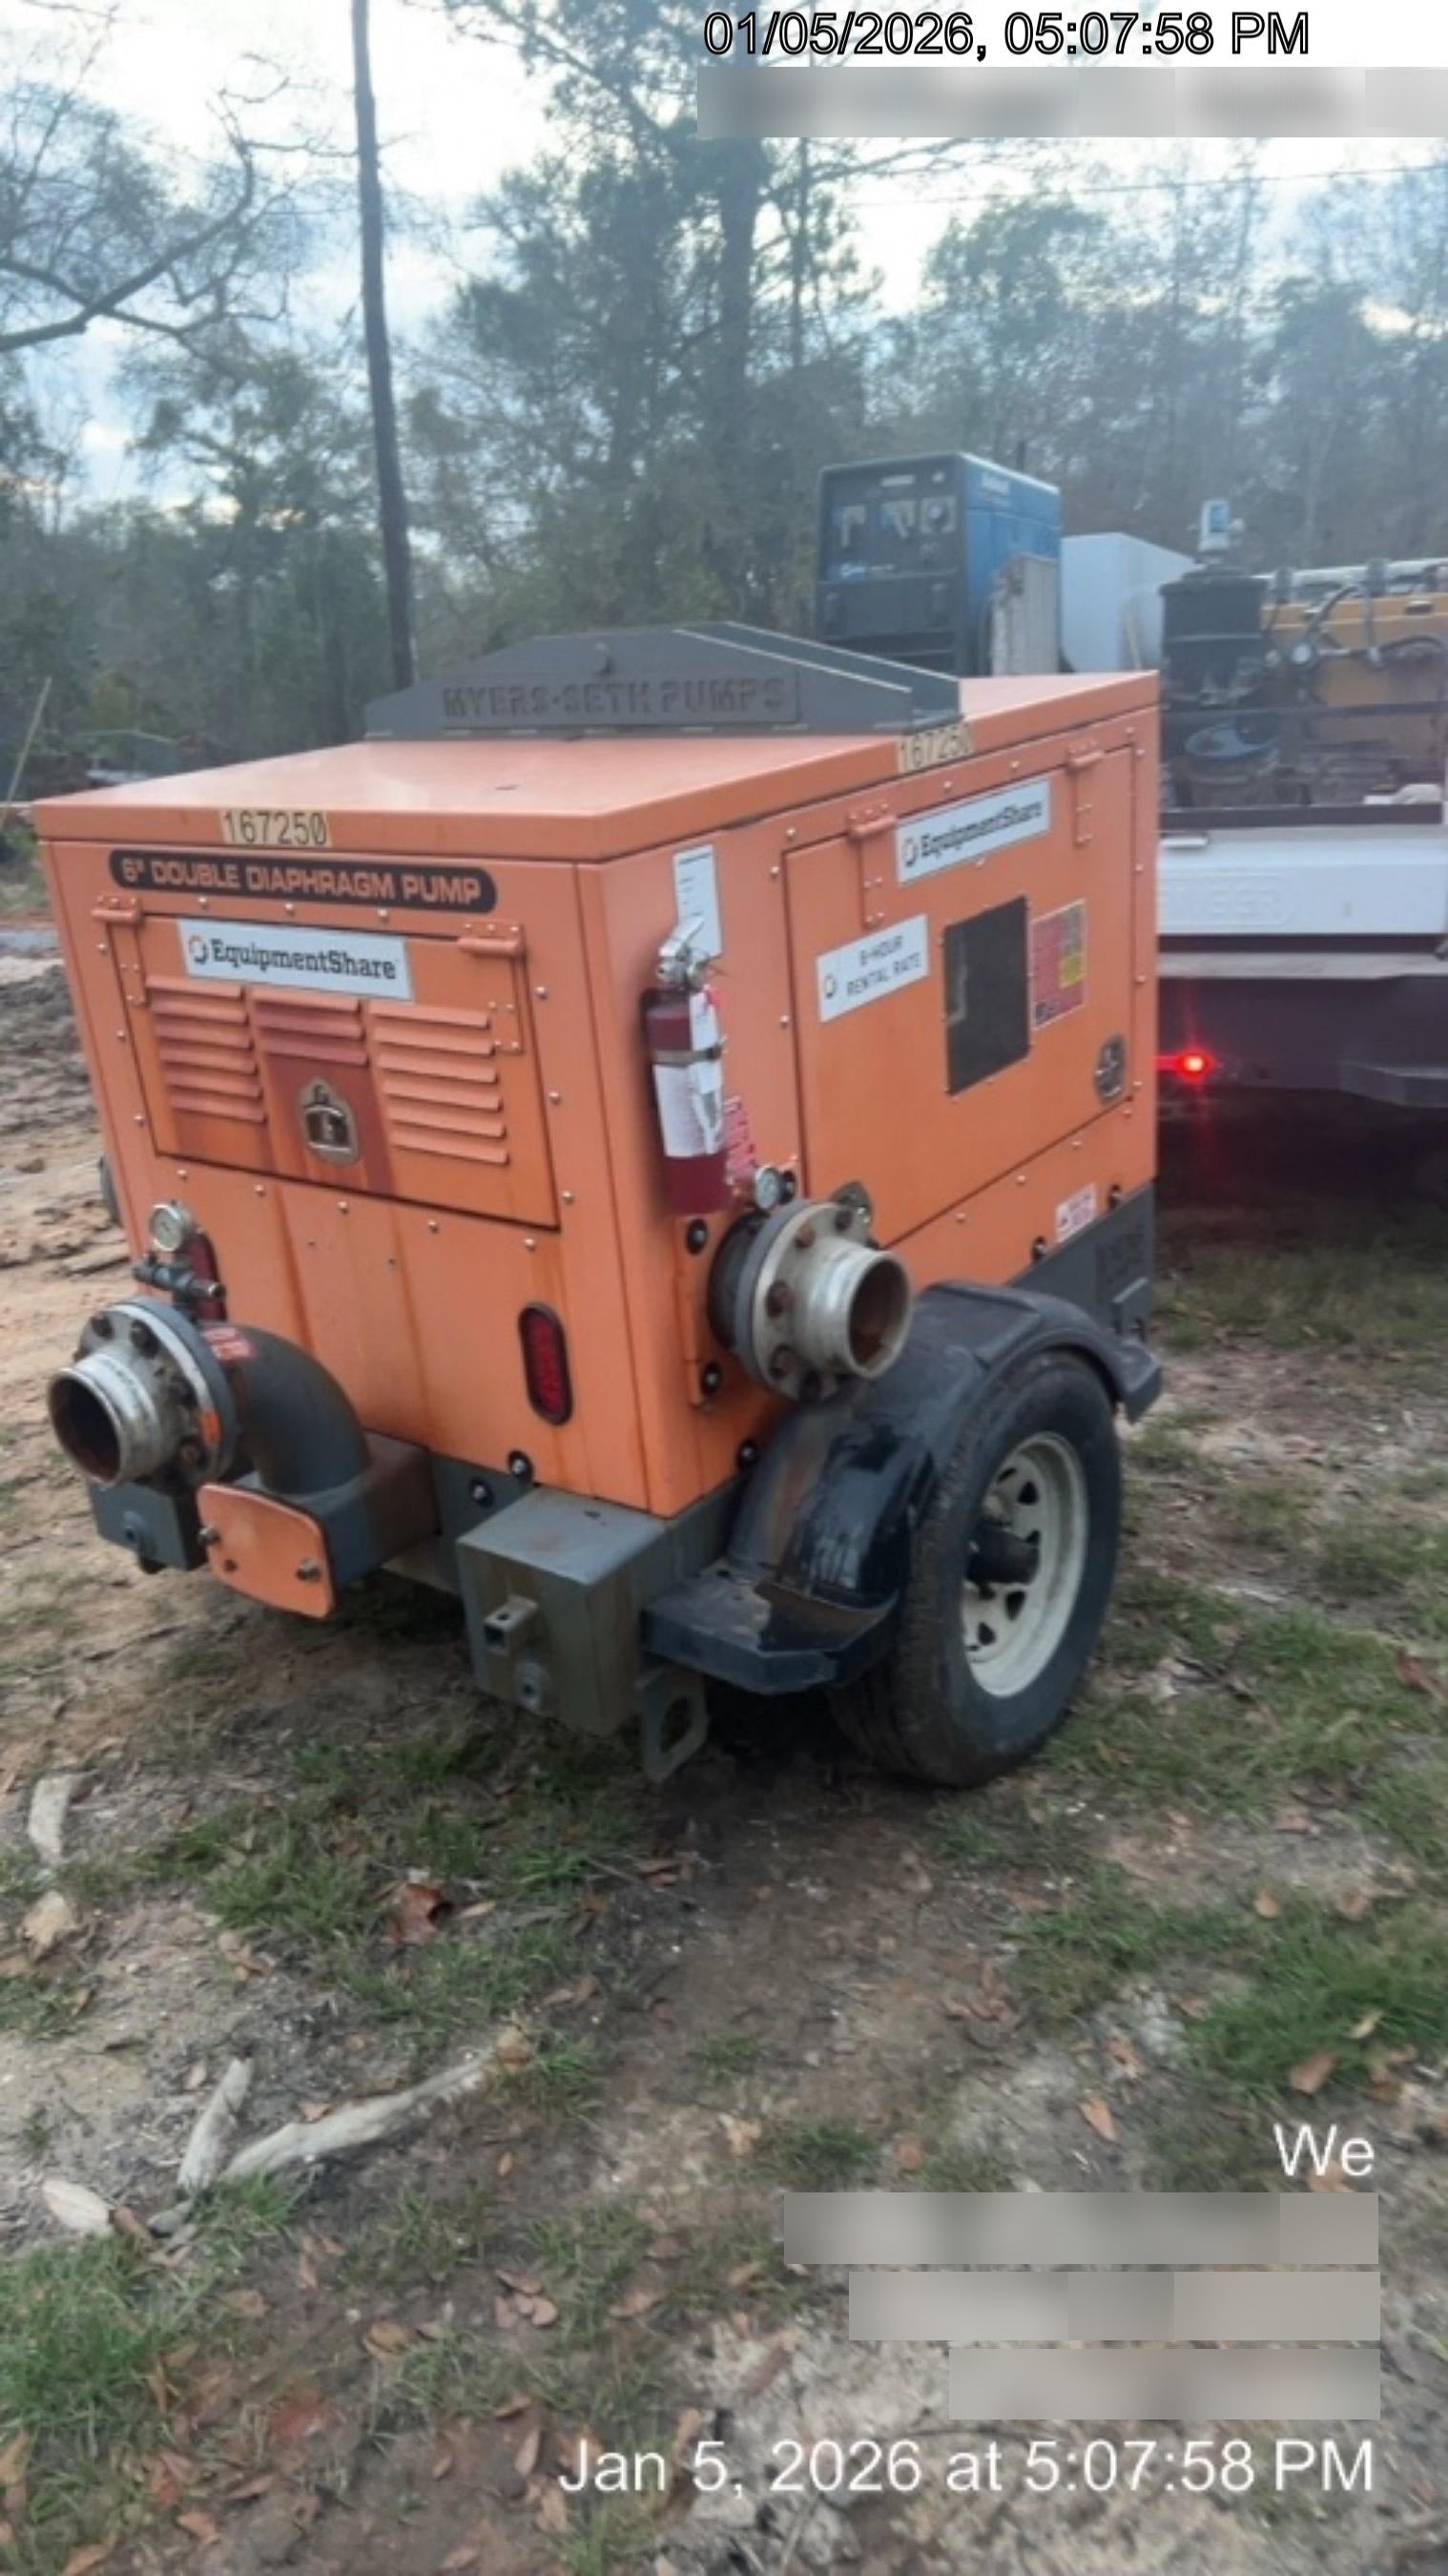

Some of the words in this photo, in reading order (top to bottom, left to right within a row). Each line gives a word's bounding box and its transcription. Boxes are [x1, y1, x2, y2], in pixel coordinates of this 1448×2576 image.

[661, 677, 785, 714] PUMPS
[222, 810, 327, 845] 167250
[920, 800, 1043, 859] EquipmentShare
[152, 862, 240, 889] DOUBLE
[246, 866, 396, 901] DIAPHRAGM
[402, 874, 481, 904] PUMP
[211, 939, 397, 981] EquipmentShare
[846, 967, 891, 996] RENTAL
[893, 951, 921, 975] RATE
